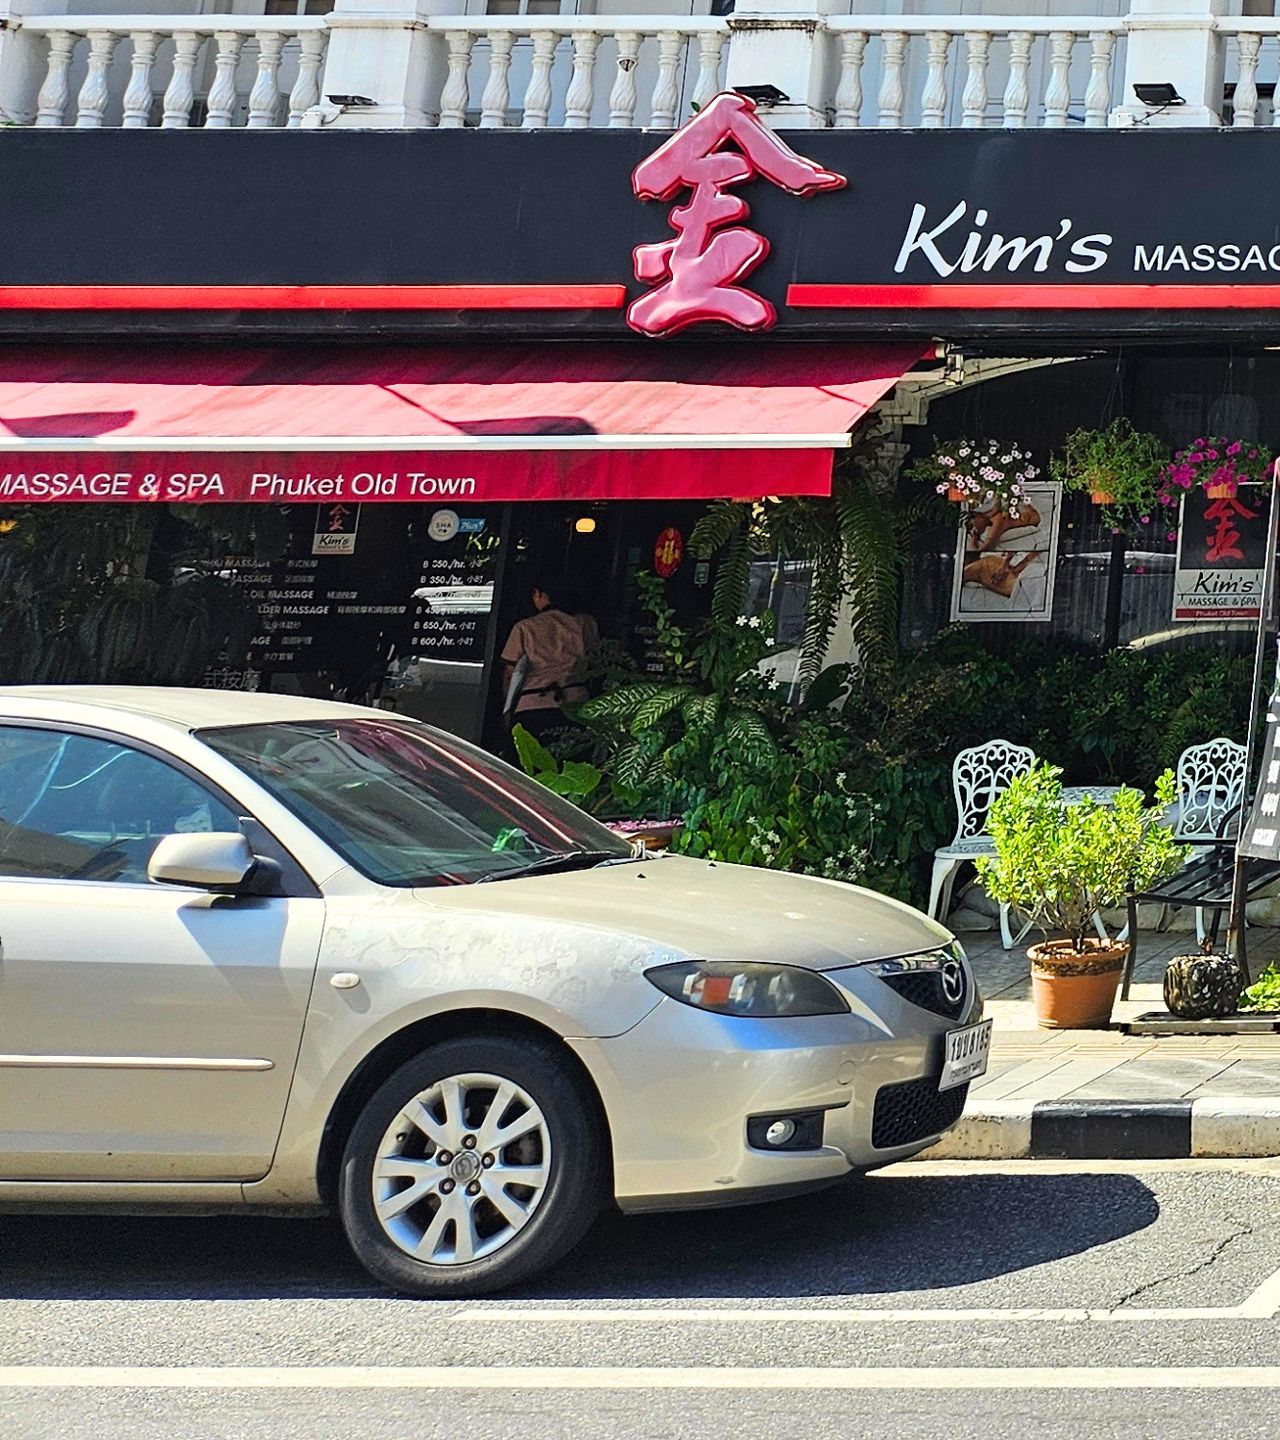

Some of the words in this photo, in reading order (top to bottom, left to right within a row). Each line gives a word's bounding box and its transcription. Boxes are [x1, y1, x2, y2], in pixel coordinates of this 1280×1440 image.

[894, 200, 1113, 278] Kim's
[138, 473, 160, 496] &
[167, 473, 225, 496] SPA
[250, 472, 344, 496] Phuket
[350, 472, 398, 496] Old
[406, 472, 477, 496] Town
[319, 534, 350, 546] Kim's
[1193, 571, 1255, 594] Kim's
[267, 590, 315, 599] MASSAGE
[1188, 597, 1229, 607] MASSAGE
[1232, 597, 1239, 606] &
[283, 605, 329, 615] MASSAGE
[1195, 609, 1218, 617] Phuket
[1219, 609, 1230, 617] Old
[1231, 609, 1249, 617] Town
